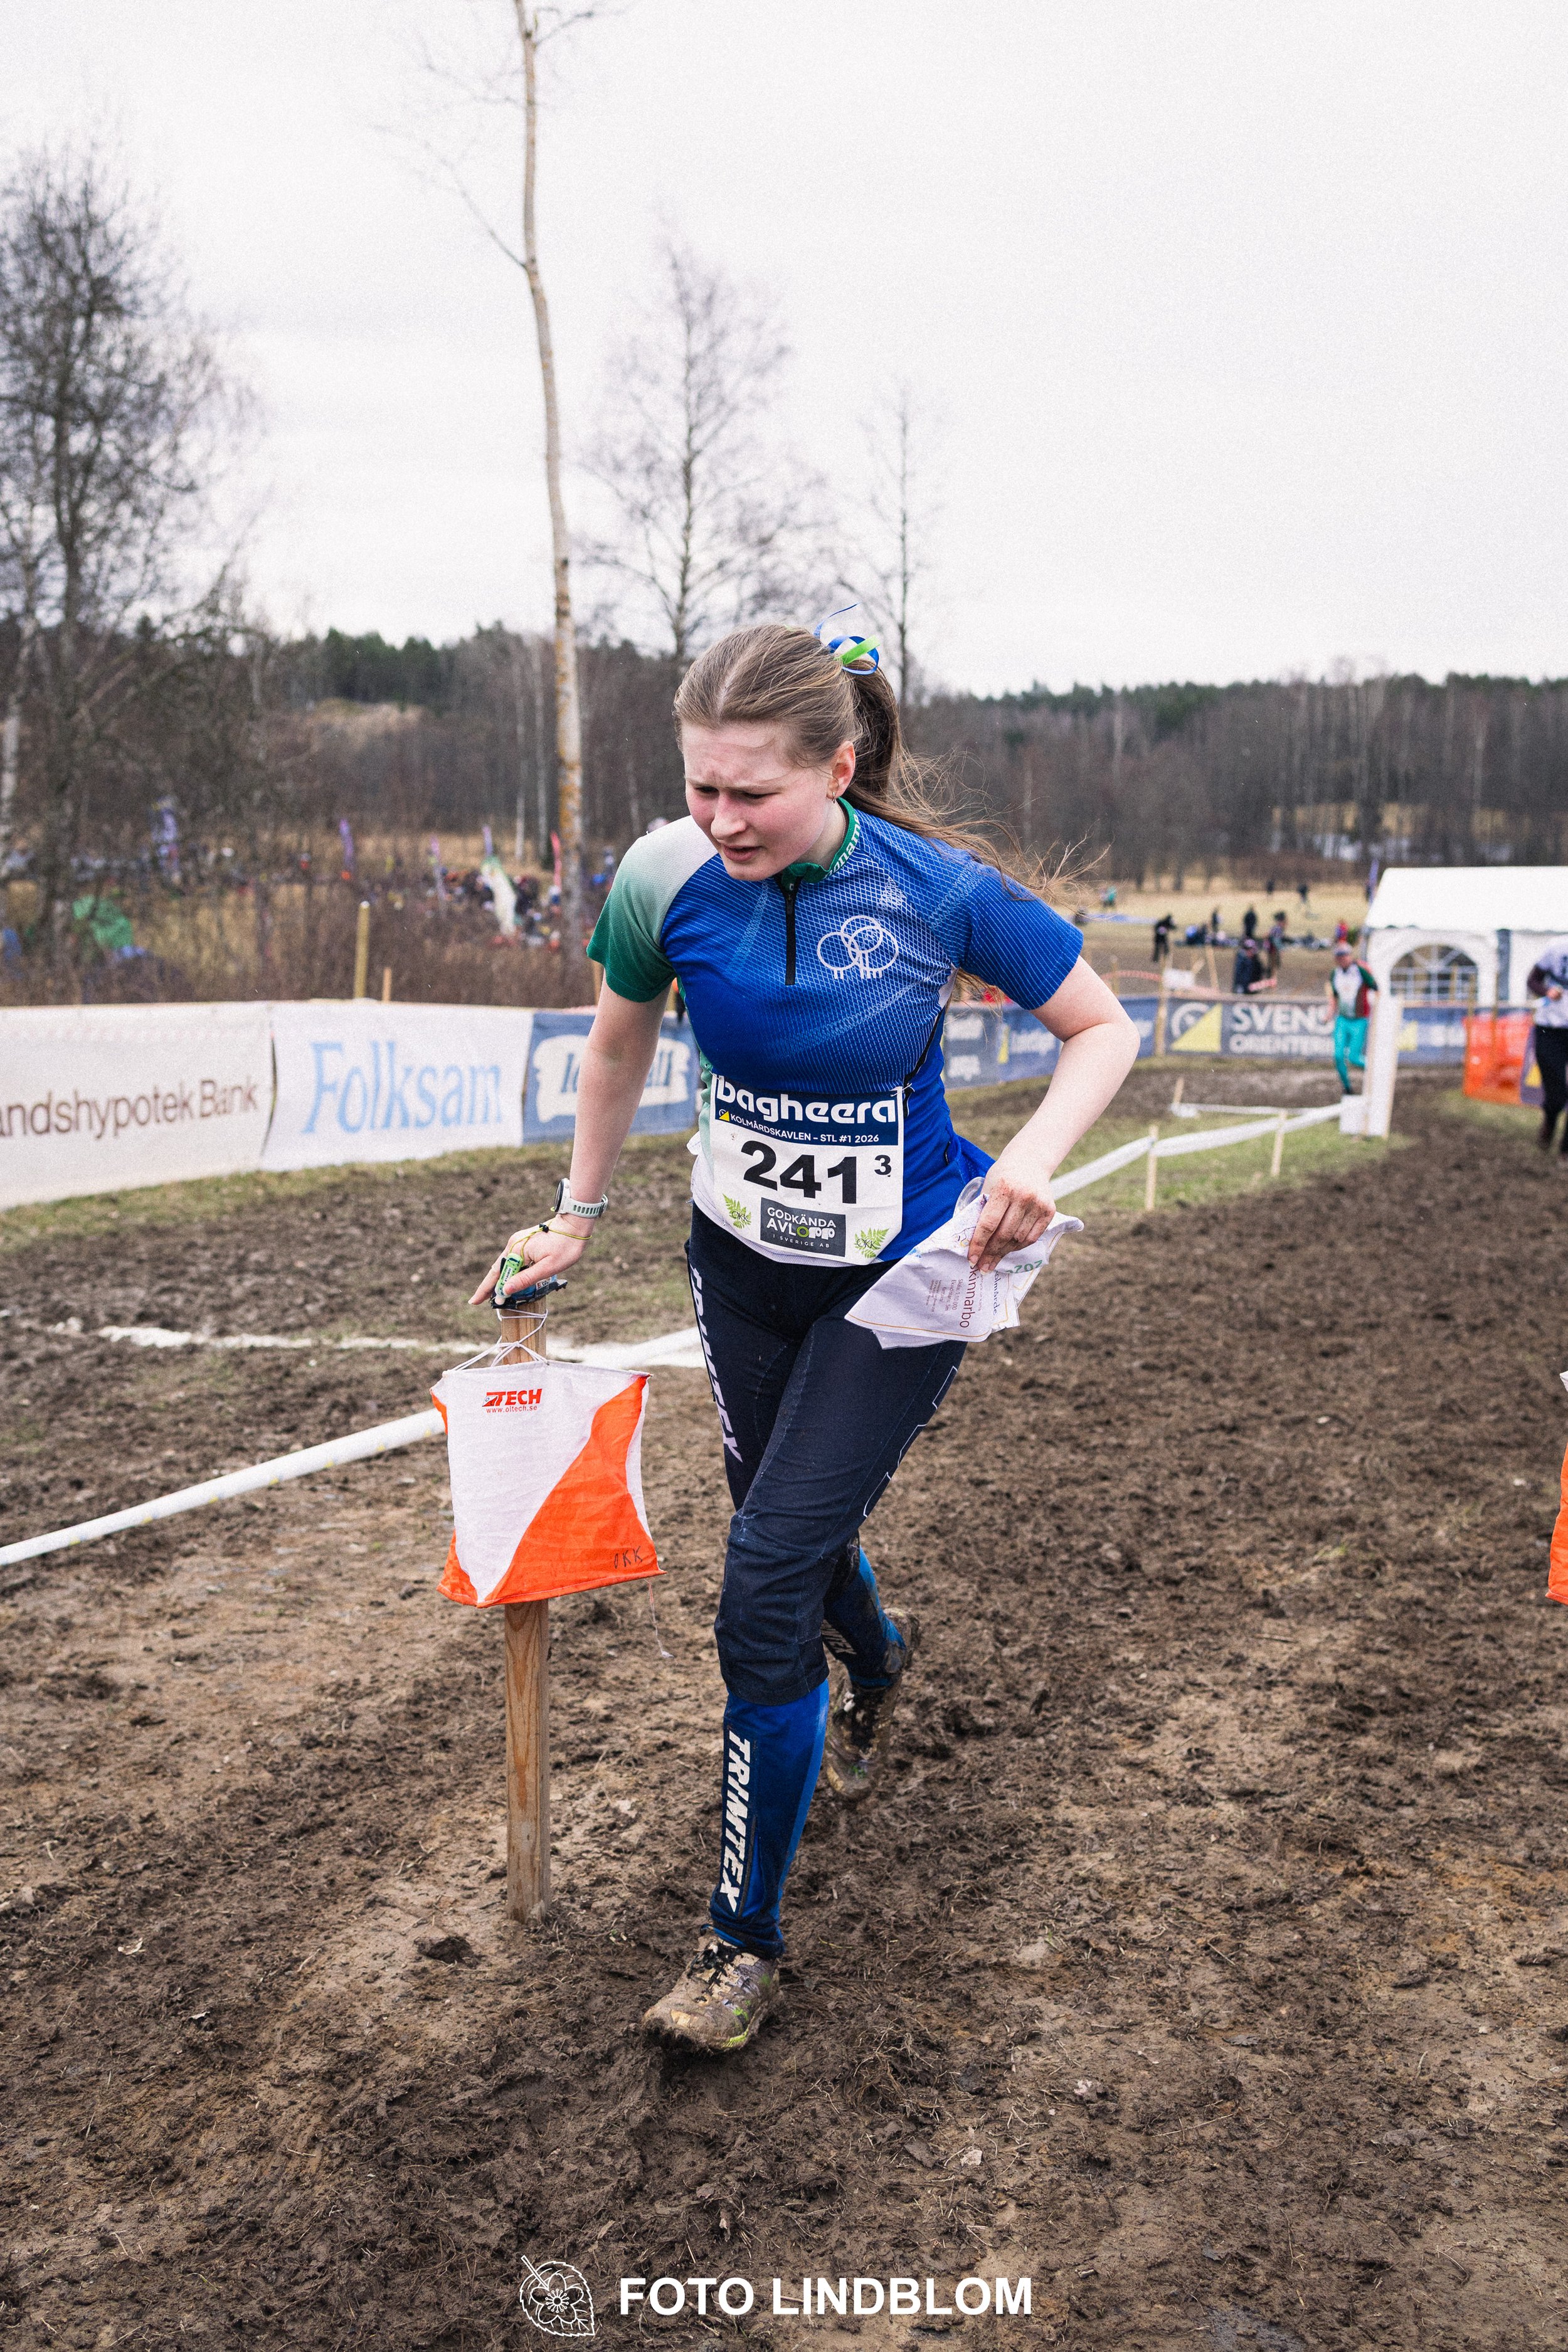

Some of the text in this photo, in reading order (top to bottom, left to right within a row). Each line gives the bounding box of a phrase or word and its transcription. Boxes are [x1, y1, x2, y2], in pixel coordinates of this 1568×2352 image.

[200, 1075, 260, 1119] Bank
[302, 1039, 503, 1134] Folksam
[717, 1075, 896, 1124] bagheera
[730, 1113, 811, 1141] KOLMÅRDSKAVLEN
[820, 1133, 837, 1143] STL
[839, 1135, 852, 1143] #1
[855, 1134, 879, 1143] 2026
[740, 1140, 857, 1204] 241
[874, 1155, 892, 1175] 3
[767, 1207, 837, 1228] GODKÄNDA
[780, 1236, 815, 1247] SVERIGE
[1005, 1259, 1043, 1274] 202
[486, 1405, 538, 1413] www.oltech.se
[720, 1730, 751, 1913] TRIMTEX
